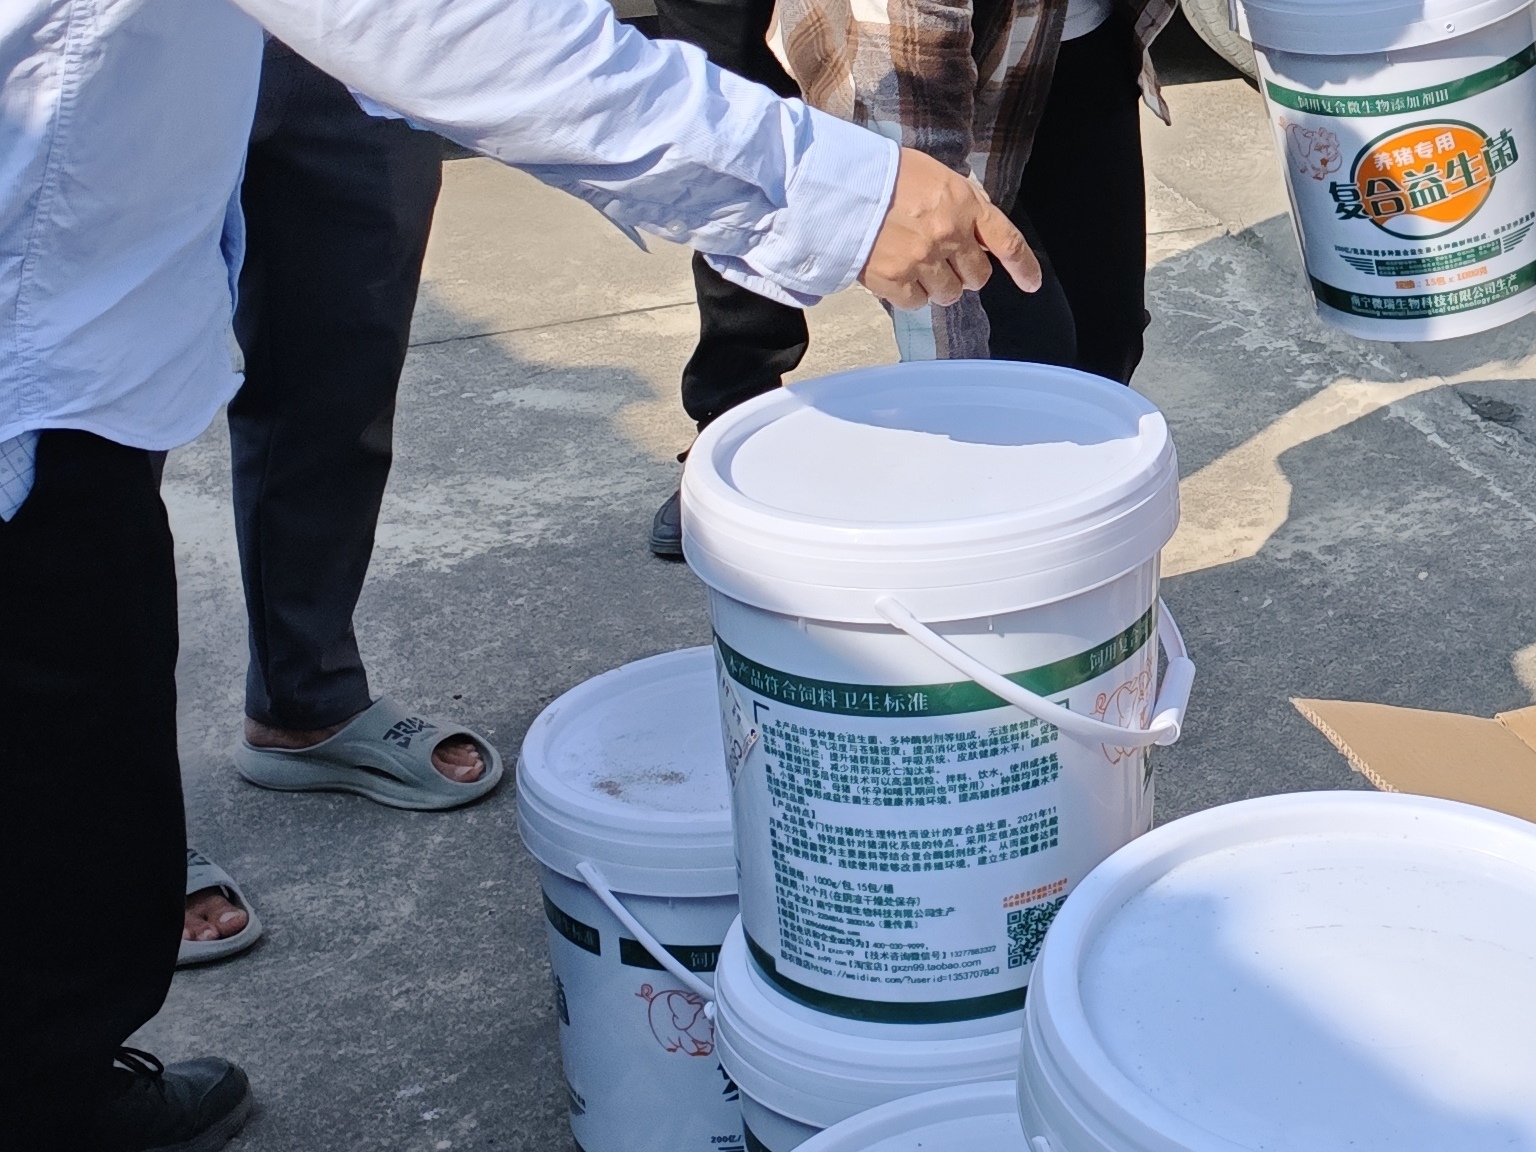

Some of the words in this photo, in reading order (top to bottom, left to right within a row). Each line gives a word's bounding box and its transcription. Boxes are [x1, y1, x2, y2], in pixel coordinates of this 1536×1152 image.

[1328, 128, 1519, 221] 复合益生菌
[1373, 132, 1456, 171] 养猪专用
[728, 655, 929, 713] 本产品符合饲料卫生标准
